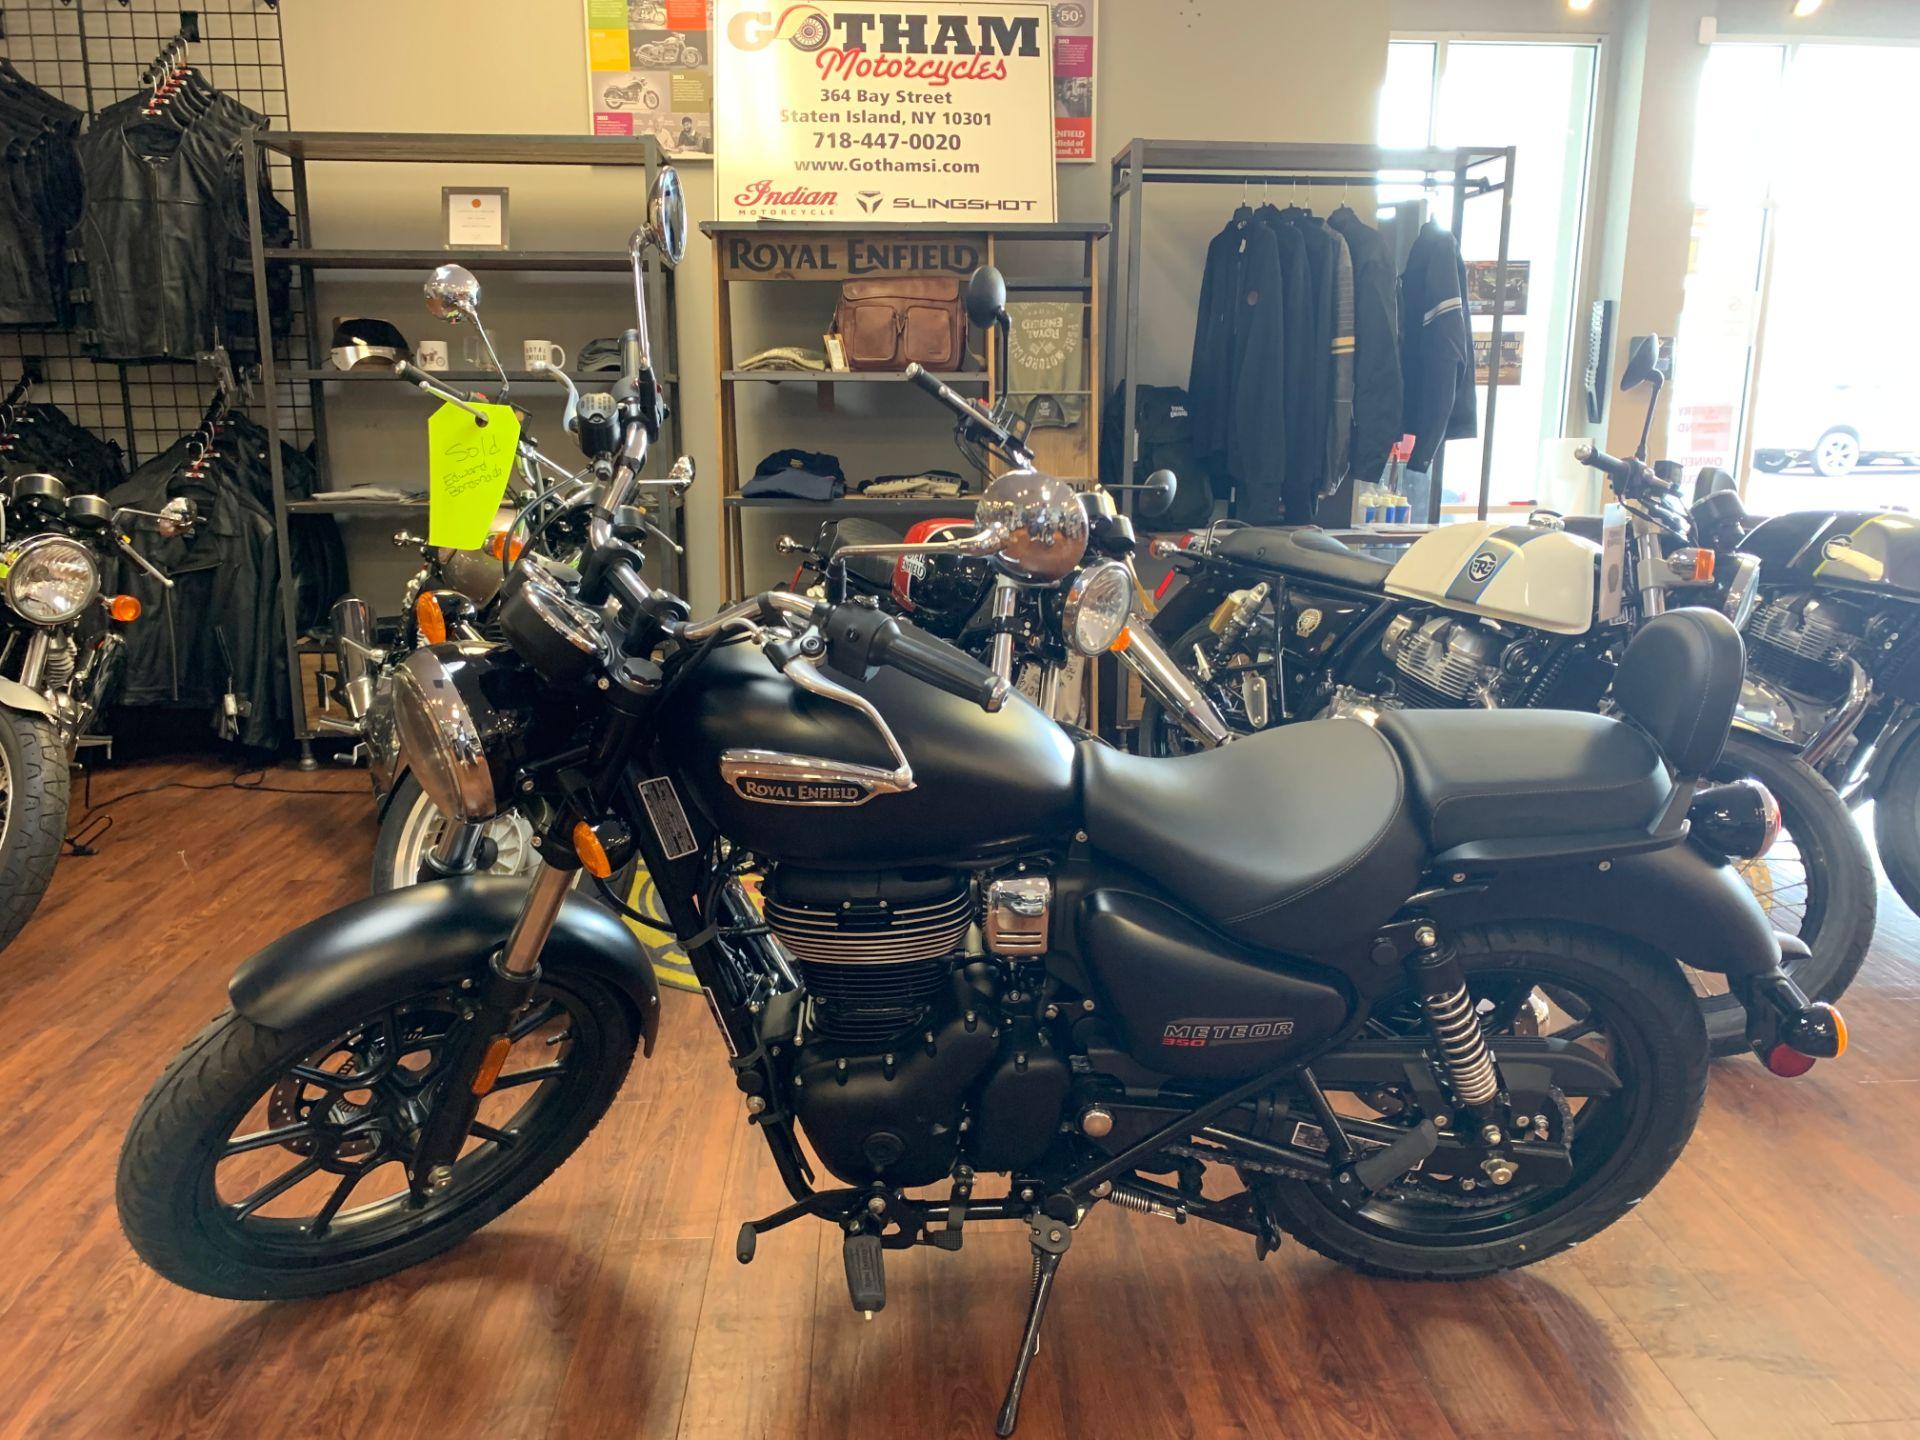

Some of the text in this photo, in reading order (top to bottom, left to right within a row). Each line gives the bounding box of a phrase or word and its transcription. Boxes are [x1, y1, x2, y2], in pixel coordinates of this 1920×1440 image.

[1061, 10, 1079, 21] 50
[727, 7, 1040, 57] GOTHAM
[816, 47, 1007, 86] Motorcycles
[820, 88, 953, 106] 364 Bay Street
[780, 109, 992, 126] Staten Island, NY 10301
[813, 131, 962, 151] 718-447-0020
[794, 157, 980, 173] www.Gothamsi.com
[734, 180, 838, 207] Indian
[738, 208, 835, 216] MOTORCYCLE
[893, 197, 1038, 211] SLINGSHOT
[729, 238, 980, 275] ROYAL ENFIELD
[444, 434, 501, 463] Sold
[746, 781, 859, 800] ROYAL ENFIELD
[1163, 1021, 1294, 1039] METEOR
[1162, 1038, 1207, 1047] 350
